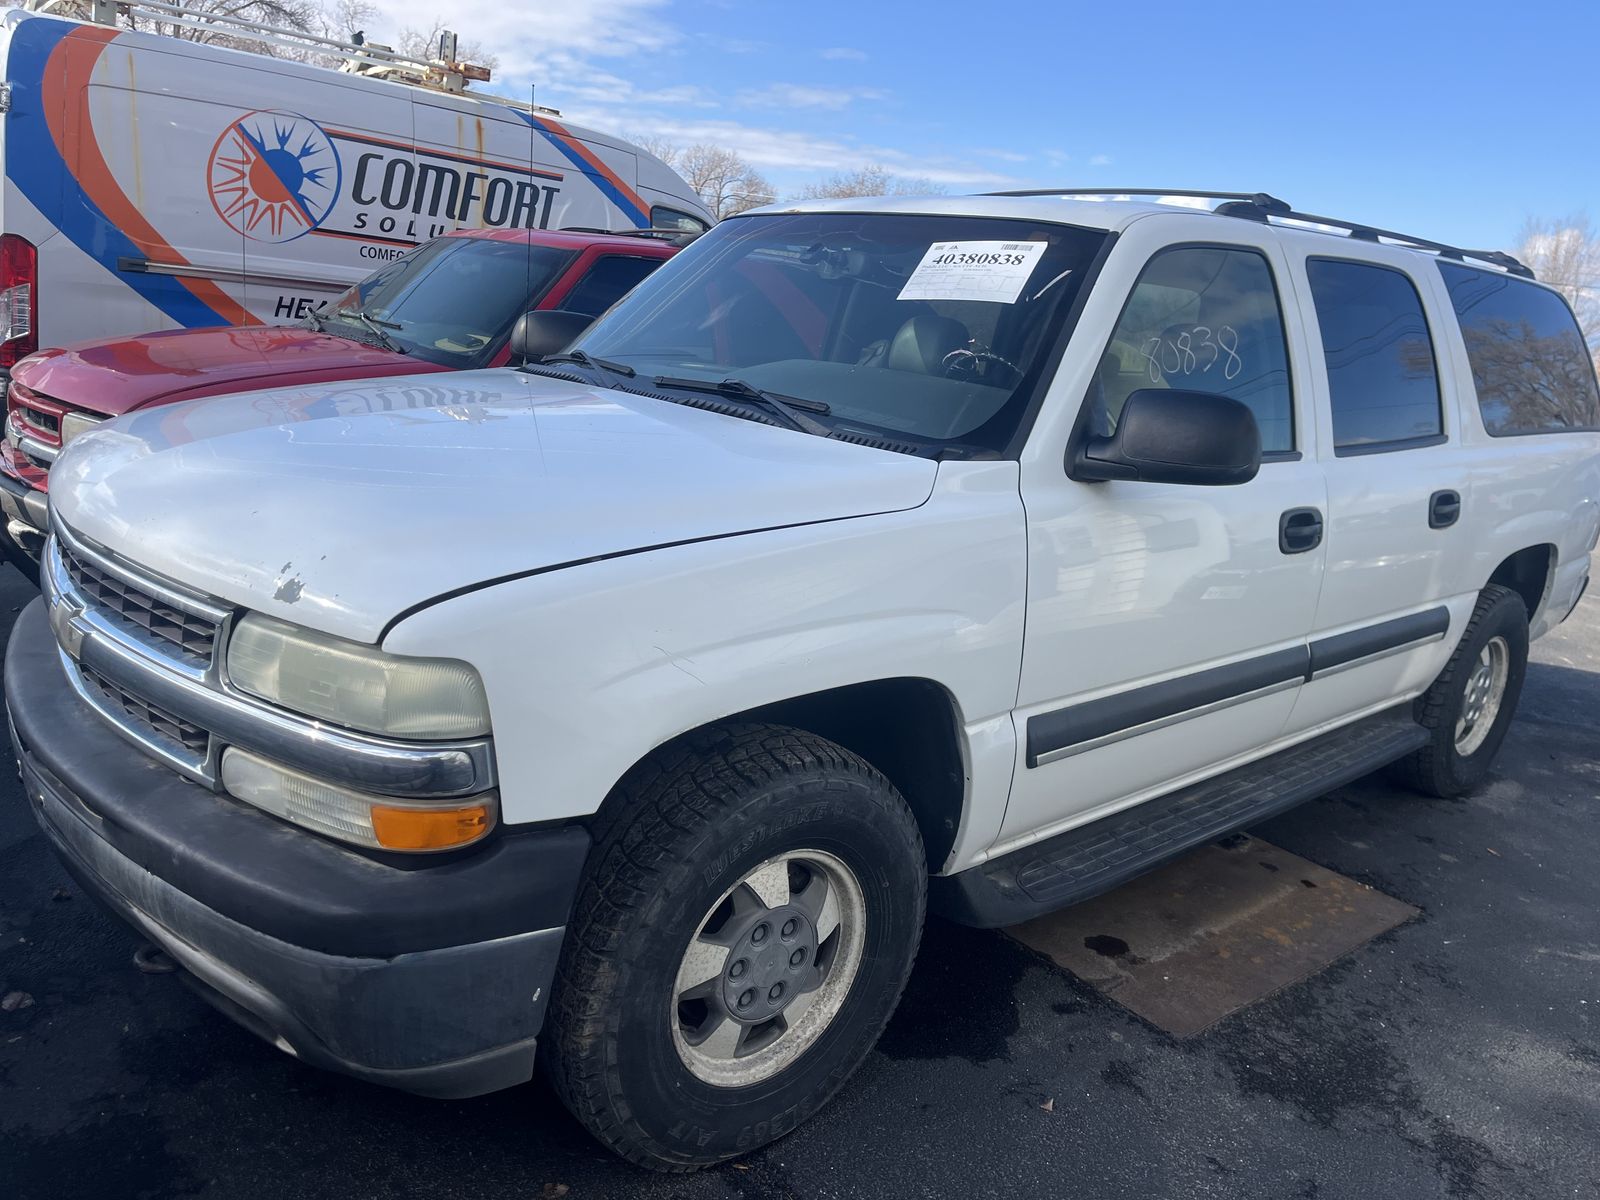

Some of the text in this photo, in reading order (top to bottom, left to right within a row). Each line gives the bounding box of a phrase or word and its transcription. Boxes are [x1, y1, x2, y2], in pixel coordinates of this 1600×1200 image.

[352, 153, 560, 230] COMFORT
[353, 212, 470, 239] SOLU
[932, 253, 1025, 266] 40380838
[1140, 325, 1242, 383] 80838
